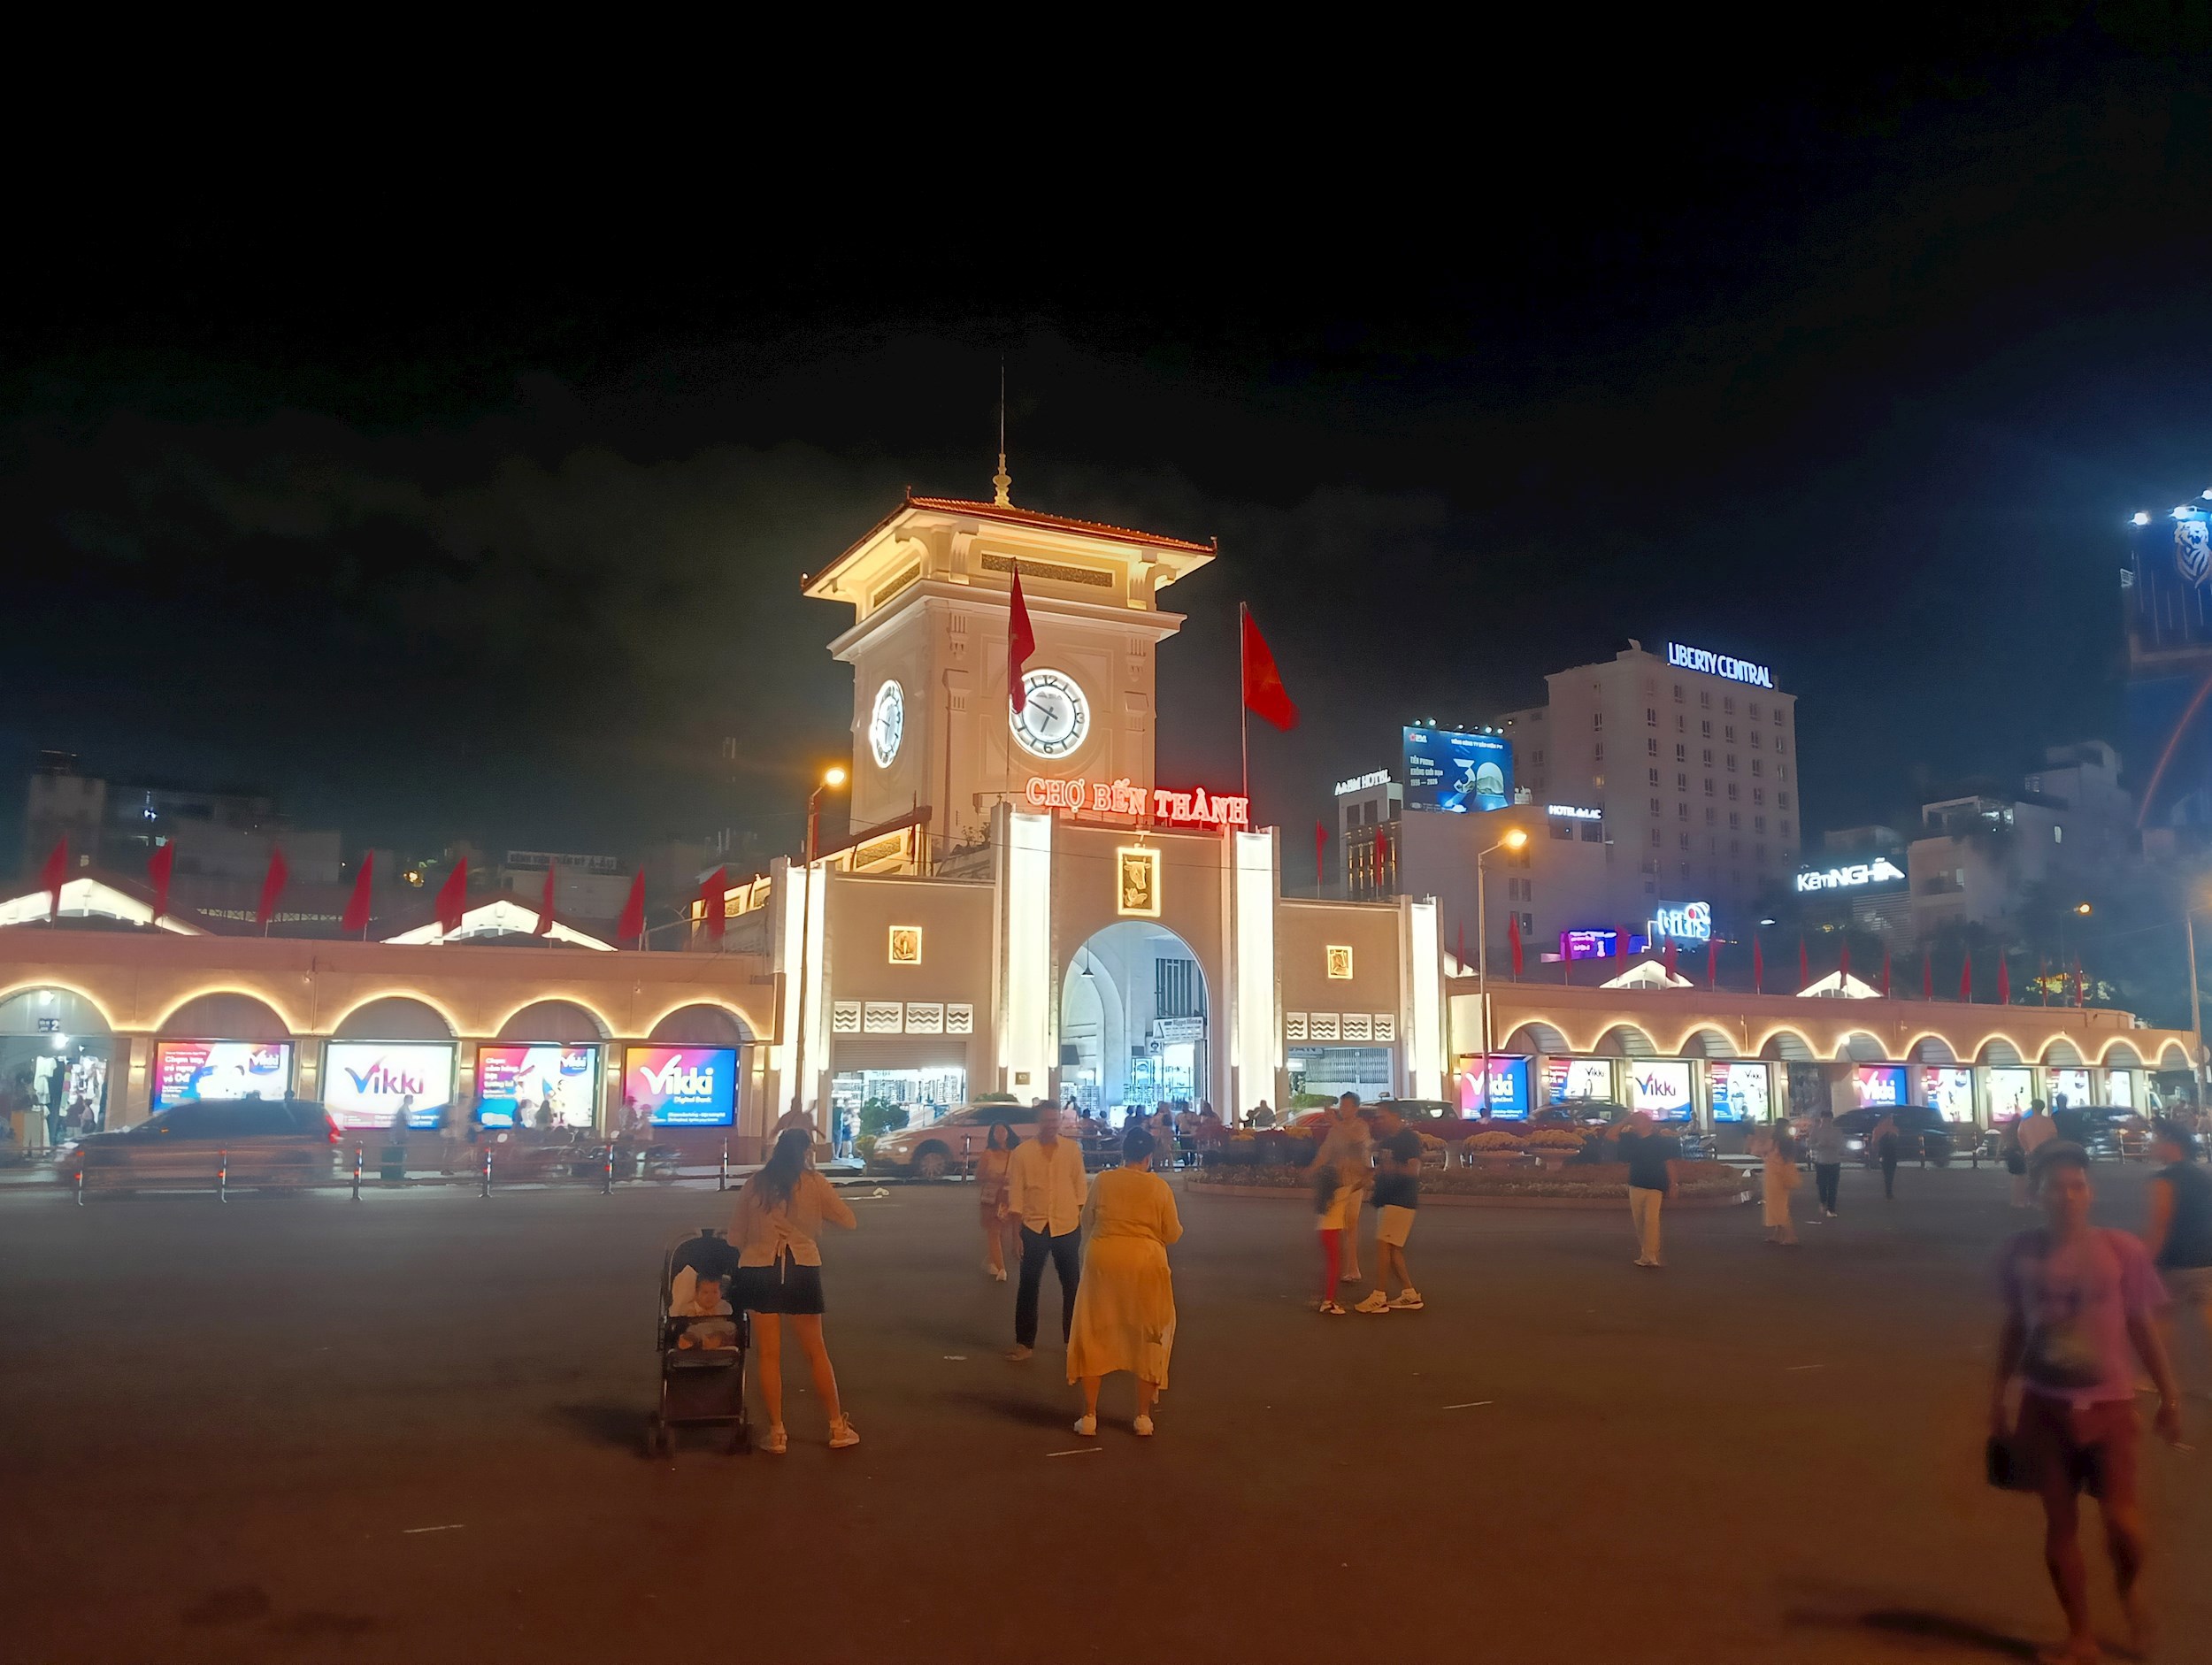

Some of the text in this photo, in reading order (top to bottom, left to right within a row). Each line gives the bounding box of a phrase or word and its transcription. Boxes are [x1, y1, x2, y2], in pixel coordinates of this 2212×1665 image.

[1669, 642, 1773, 688] LIBERTY CENTRAL
[1043, 675, 1058, 687] 12
[1361, 769, 1391, 789] HOTEL
[1025, 777, 1248, 825] CHỢ BẾN THÀNH
[1549, 805, 1576, 817] HOTEL
[51, 1020, 58, 1031] 2
[344, 1054, 424, 1094] Vikki
[640, 1054, 714, 1094] Vikki
[1465, 1063, 1514, 1096] Vkki
[1585, 1065, 1605, 1078] Vikki
[1635, 1070, 1676, 1096] Vikki
[1745, 1070, 1763, 1079] Vikki
[1858, 1070, 1895, 1101] Vikki
